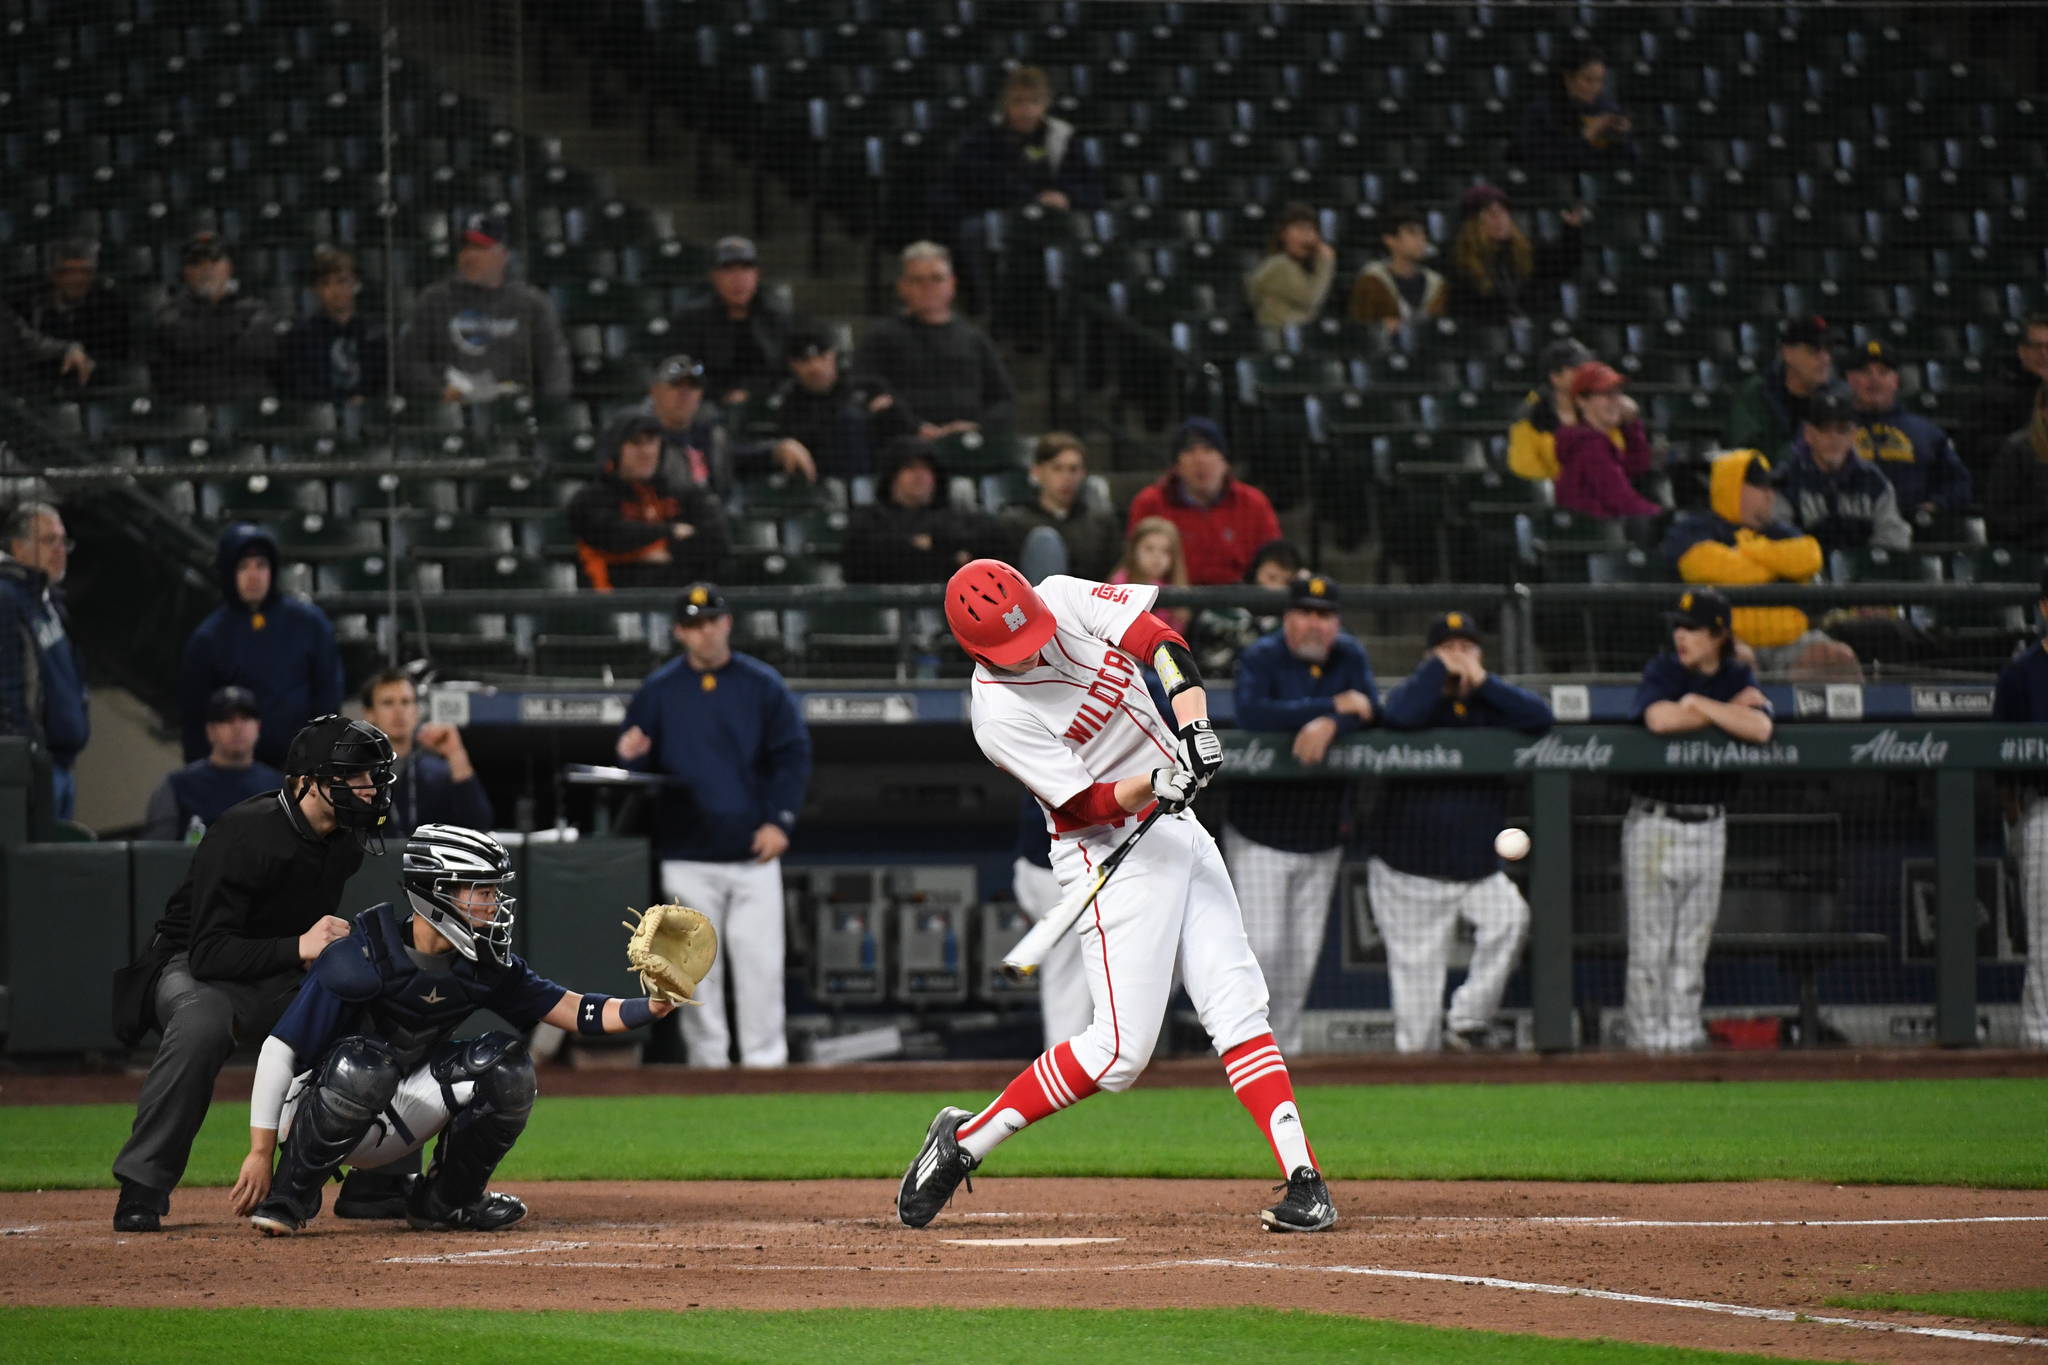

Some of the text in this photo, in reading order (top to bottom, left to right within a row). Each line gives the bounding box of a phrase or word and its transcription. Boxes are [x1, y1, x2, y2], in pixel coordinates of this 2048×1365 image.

[1916, 691, 1988, 708] MLB.com
[1513, 734, 1613, 771] Alaska
[1666, 741, 1798, 769] #iFlyAlaska
[1851, 729, 1948, 767] Alaska
